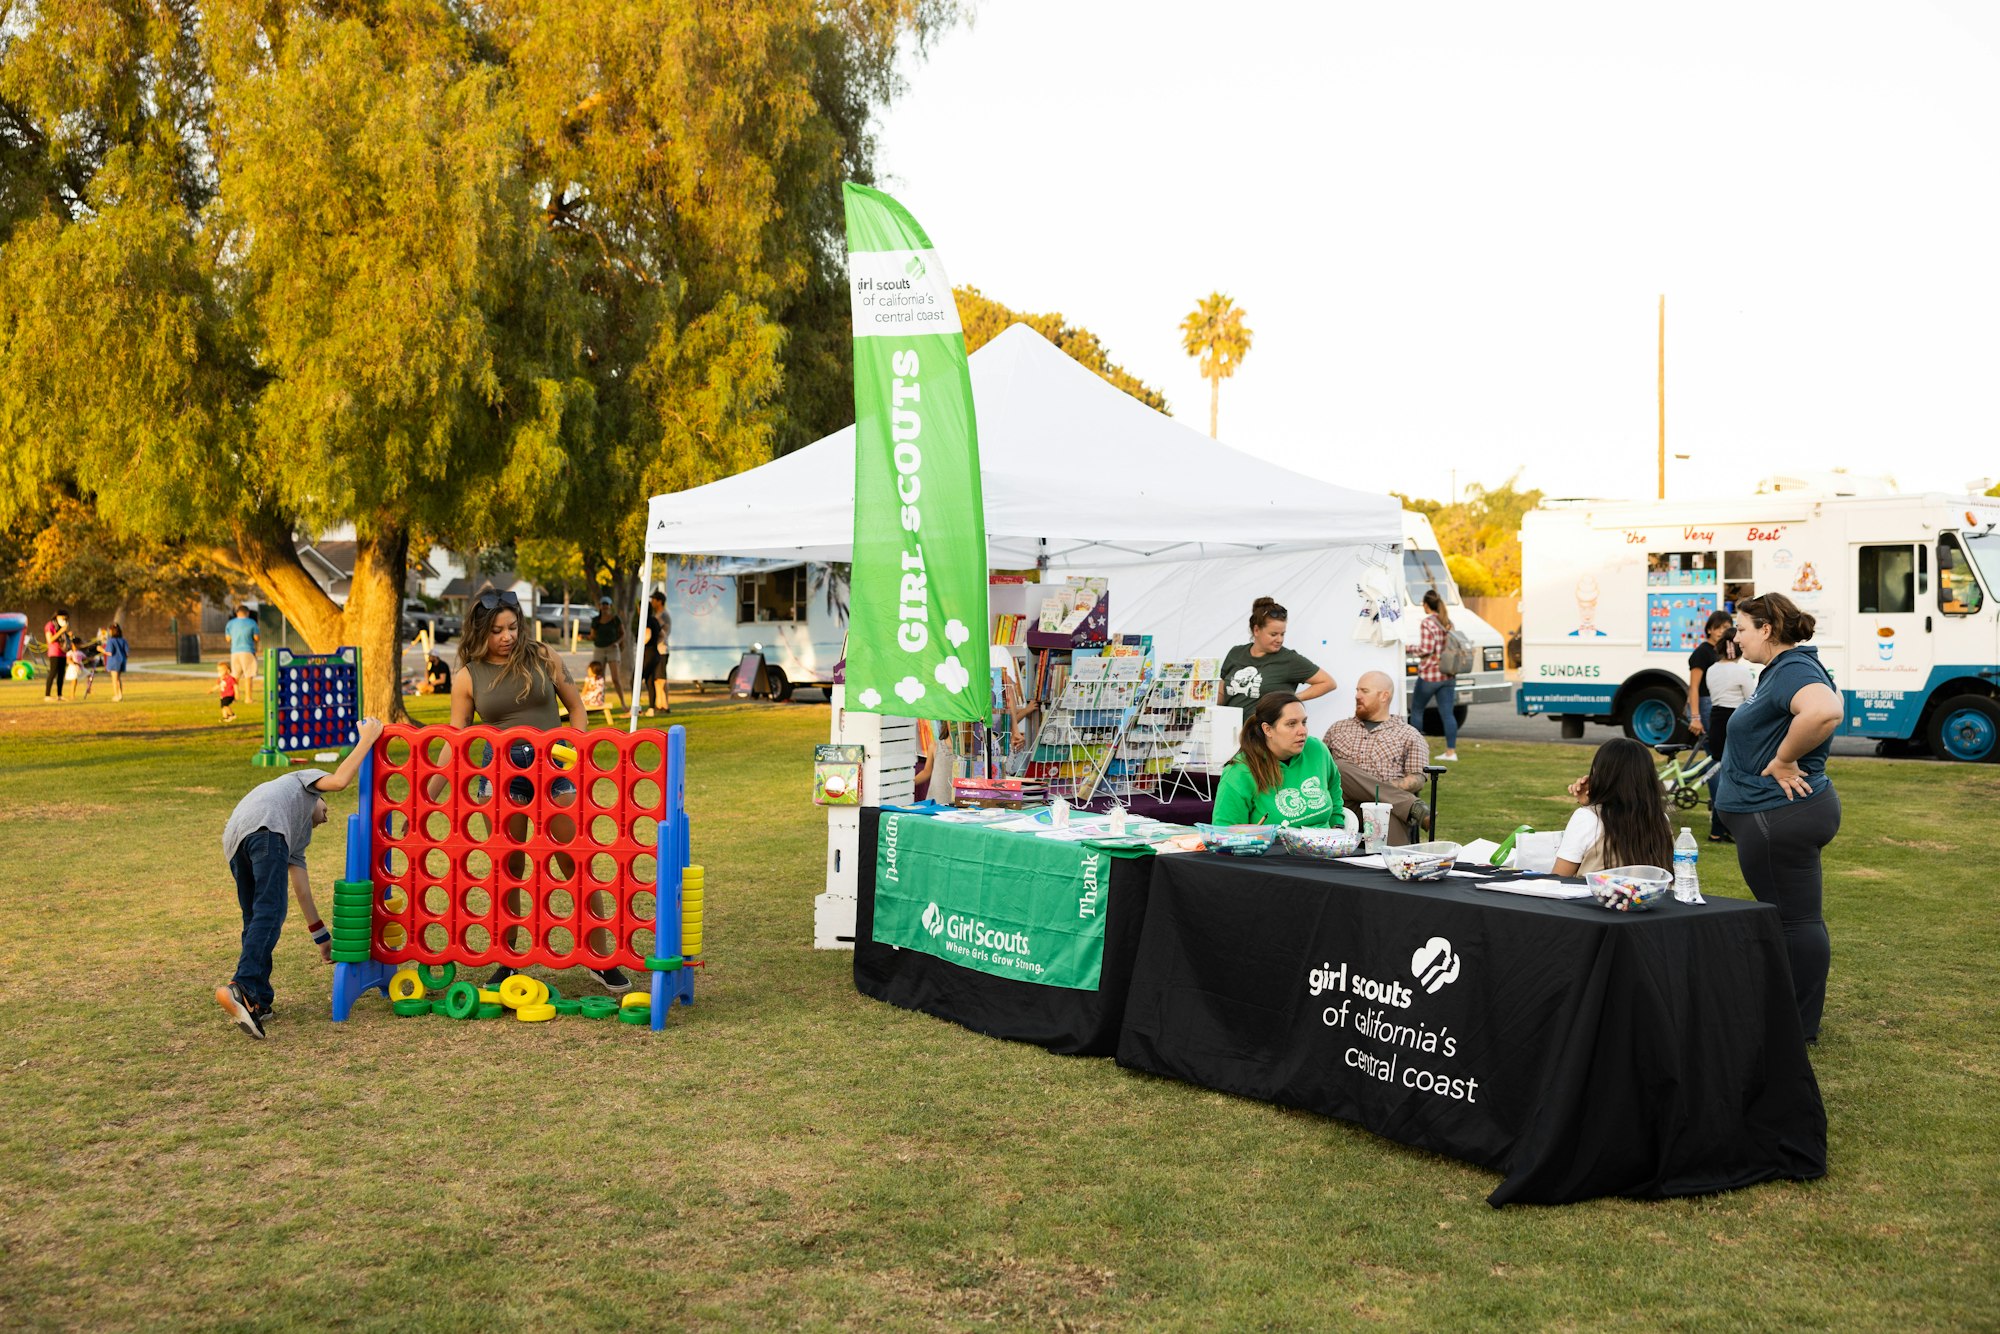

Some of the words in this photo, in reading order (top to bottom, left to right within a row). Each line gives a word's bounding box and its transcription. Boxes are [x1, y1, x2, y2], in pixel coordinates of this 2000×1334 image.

[876, 278, 911, 291] scouts
[863, 294, 876, 306] of
[878, 293, 934, 307] california's
[874, 309, 914, 322] central
[917, 310, 945, 321] coast
[892, 349, 922, 533] SCOUTS
[1684, 526, 1715, 544] Very
[897, 544, 928, 652] GIRL
[1540, 664, 1600, 677] SUNDAES
[1855, 689, 1879, 699] MISTER
[1880, 690, 1904, 700] SOFTEE
[1863, 700, 1873, 708] OF
[1874, 700, 1896, 709] SOCAL
[885, 814, 900, 882] upport!
[1079, 852, 1100, 918] Thank
[945, 941, 970, 956] Where
[972, 948, 988, 960] Grls
[992, 953, 1014, 966] Grow
[1308, 961, 1348, 996] girl
[1352, 974, 1413, 1009] scouts
[1322, 1000, 1351, 1027] of
[1354, 1007, 1457, 1057] california's
[1344, 1047, 1397, 1083] central
[1402, 1067, 1479, 1104] coast
